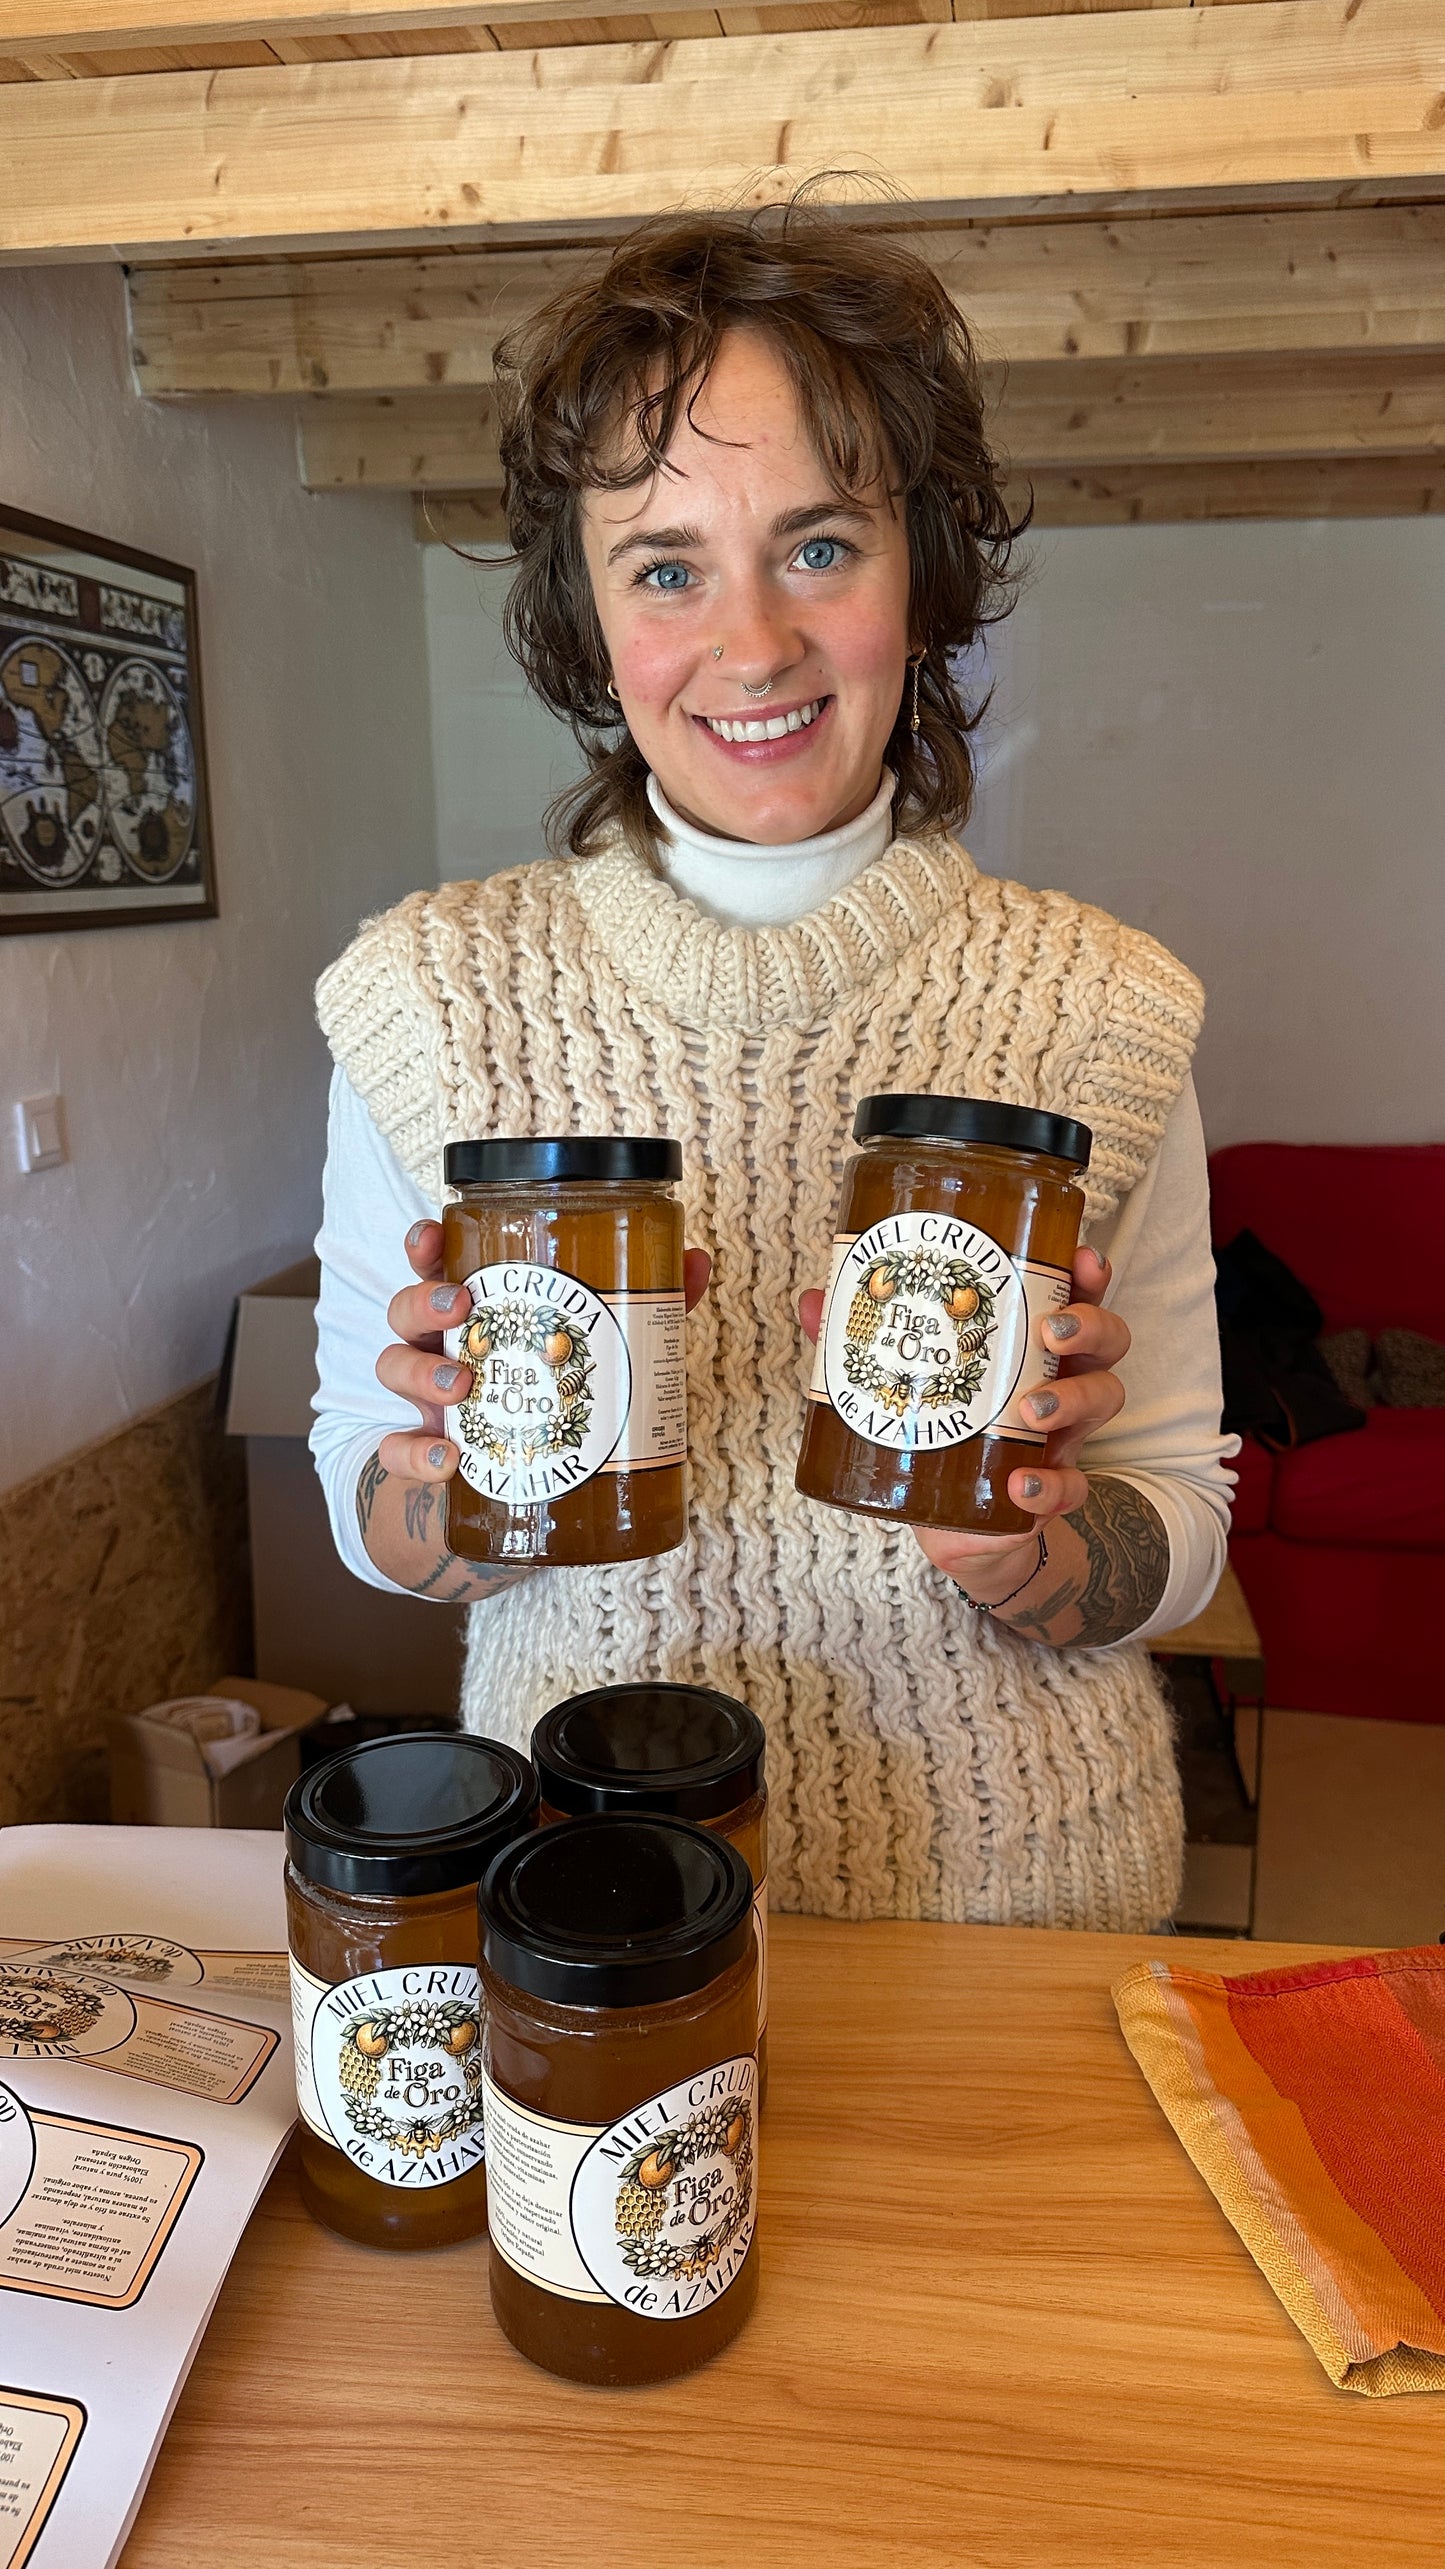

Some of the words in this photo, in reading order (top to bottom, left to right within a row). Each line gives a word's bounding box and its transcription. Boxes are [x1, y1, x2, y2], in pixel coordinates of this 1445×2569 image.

[852, 1218, 910, 1271] MIEL
[919, 1218, 1012, 1295] CRUDA
[466, 1276, 495, 1306] EL
[504, 1268, 601, 1334] CRUDA
[888, 1303, 941, 1338] Figa
[880, 1331, 896, 1347] de
[897, 1333, 951, 1365] Oro
[488, 1359, 539, 1391] Figa
[486, 1388, 500, 1404] de
[501, 1388, 554, 1416] Oro
[838, 1389, 858, 1420] de
[862, 1410, 974, 1445] AZAHAR
[459, 1452, 477, 1480] de
[65, 1938, 162, 1951] AZAHAR
[160, 1945, 184, 1958] de
[93, 1984, 118, 1996] de
[327, 1979, 393, 2024] MIEL
[403, 1971, 479, 2001] CRU
[5, 2042, 80, 2055] MIEL
[387, 2057, 446, 2086] Figa
[384, 2085, 400, 2099] de
[403, 2083, 461, 2108] Oro
[599, 2102, 679, 2166] MIEL
[688, 2063, 755, 2106] CRUDA
[92, 2149, 117, 2160] España
[346, 2138, 374, 2167] de
[75, 2155, 107, 2166] artesanal
[118, 2154, 141, 2165] Origen
[72, 2164, 99, 2173] natural
[108, 2162, 149, 2176] Elaboración
[123, 2174, 143, 2184] 100%
[43, 2186, 82, 2198] respetando
[71, 2183, 92, 2191] sabor
[99, 2188, 121, 2196] aroma
[673, 2167, 724, 2208] Figa
[31, 2193, 62, 2205] decantar
[64, 2199, 79, 2209] deja
[111, 2200, 138, 2209] manera
[139, 2205, 148, 2213] de
[670, 2211, 685, 2227] de
[688, 2185, 735, 2226] Oro
[118, 2211, 141, 2219] extrae
[34, 2223, 69, 2235] vitaminas
[15, 2238, 60, 2250] conservando
[60, 2237, 87, 2247] natural
[88, 2243, 110, 2253] forma
[43, 2262, 65, 2271] cruda
[71, 2258, 97, 2268] somete
[624, 2283, 658, 2310] de
[662, 2221, 752, 2313] AZAHAR
[65, 2267, 82, 2275] miel
[83, 2270, 112, 2282] Nuestra
